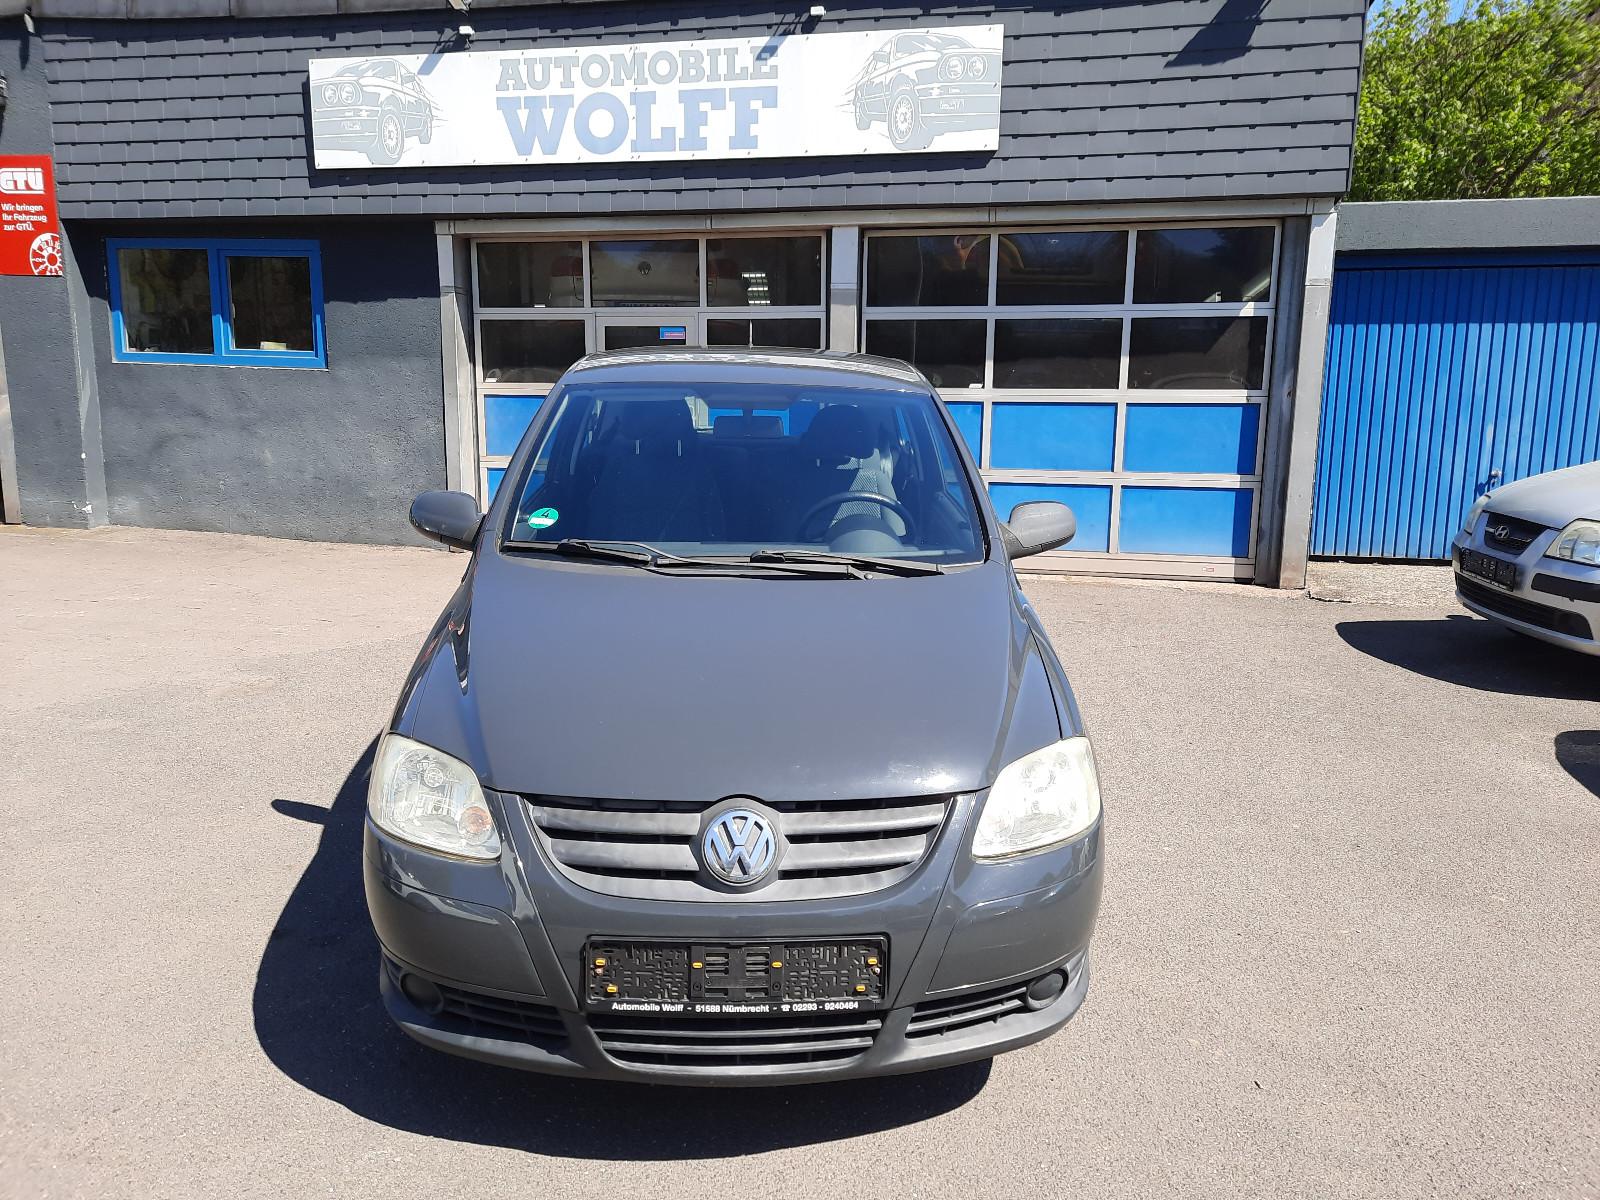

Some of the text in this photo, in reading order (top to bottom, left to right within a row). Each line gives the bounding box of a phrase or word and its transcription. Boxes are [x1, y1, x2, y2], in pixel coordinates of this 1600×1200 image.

[495, 46, 778, 91] AUTOMOBILE
[495, 86, 778, 156] WOLFF
[1, 203, 43, 213] Wir bringen
[2, 213, 47, 223] Ihr Fahrzeug
[541, 509, 552, 519] 4
[611, 1002, 660, 1012] Automobile
[661, 1003, 684, 1012] Wolff
[695, 1004, 721, 1013] 51588
[722, 1004, 770, 1013] Nümbrecht
[792, 1003, 818, 1012] 02293
